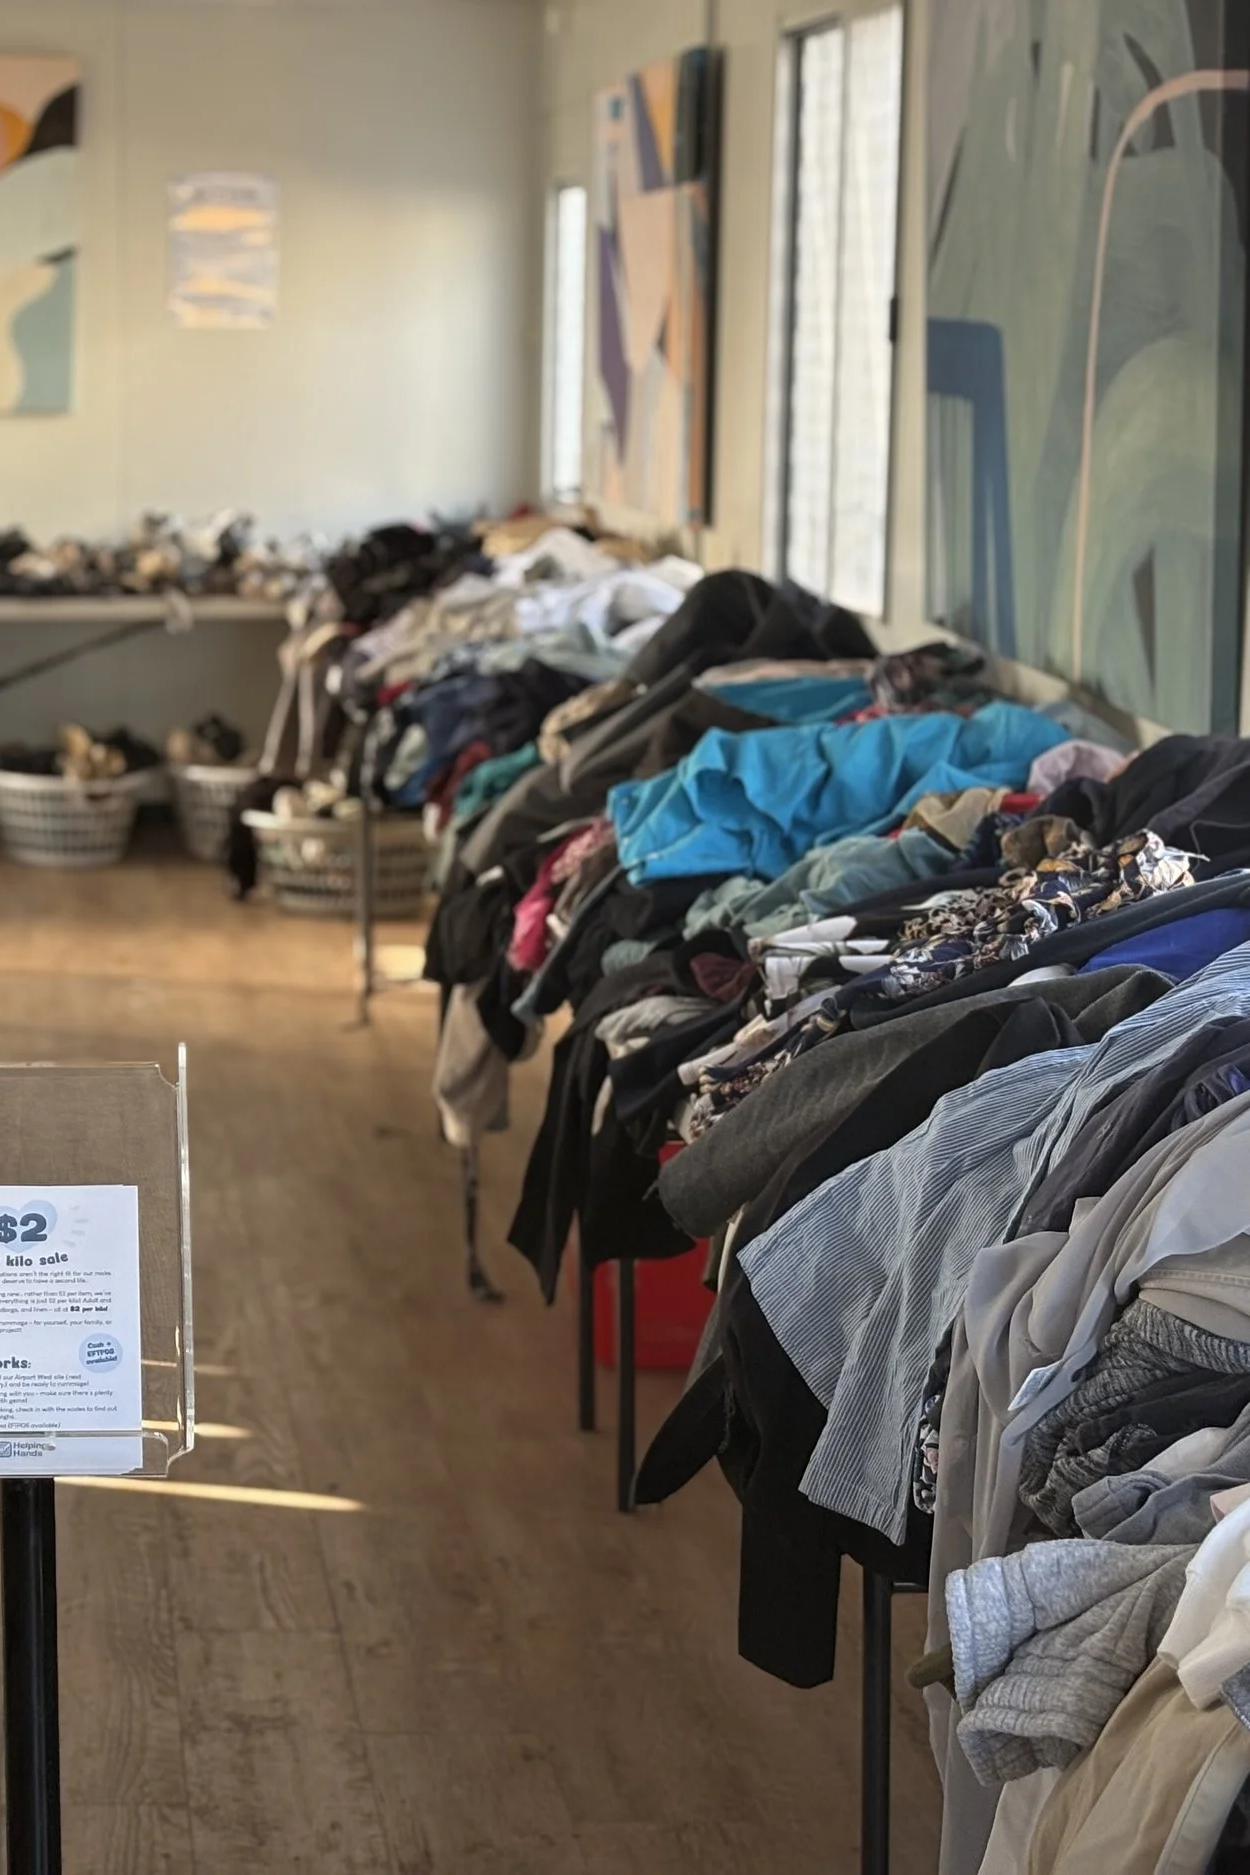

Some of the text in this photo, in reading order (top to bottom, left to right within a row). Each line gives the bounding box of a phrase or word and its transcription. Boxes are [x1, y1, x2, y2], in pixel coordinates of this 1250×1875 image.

[6, 1255, 33, 1266] kilo
[39, 1252, 69, 1265] sale
[87, 1348, 114, 1357] EFTPOS
